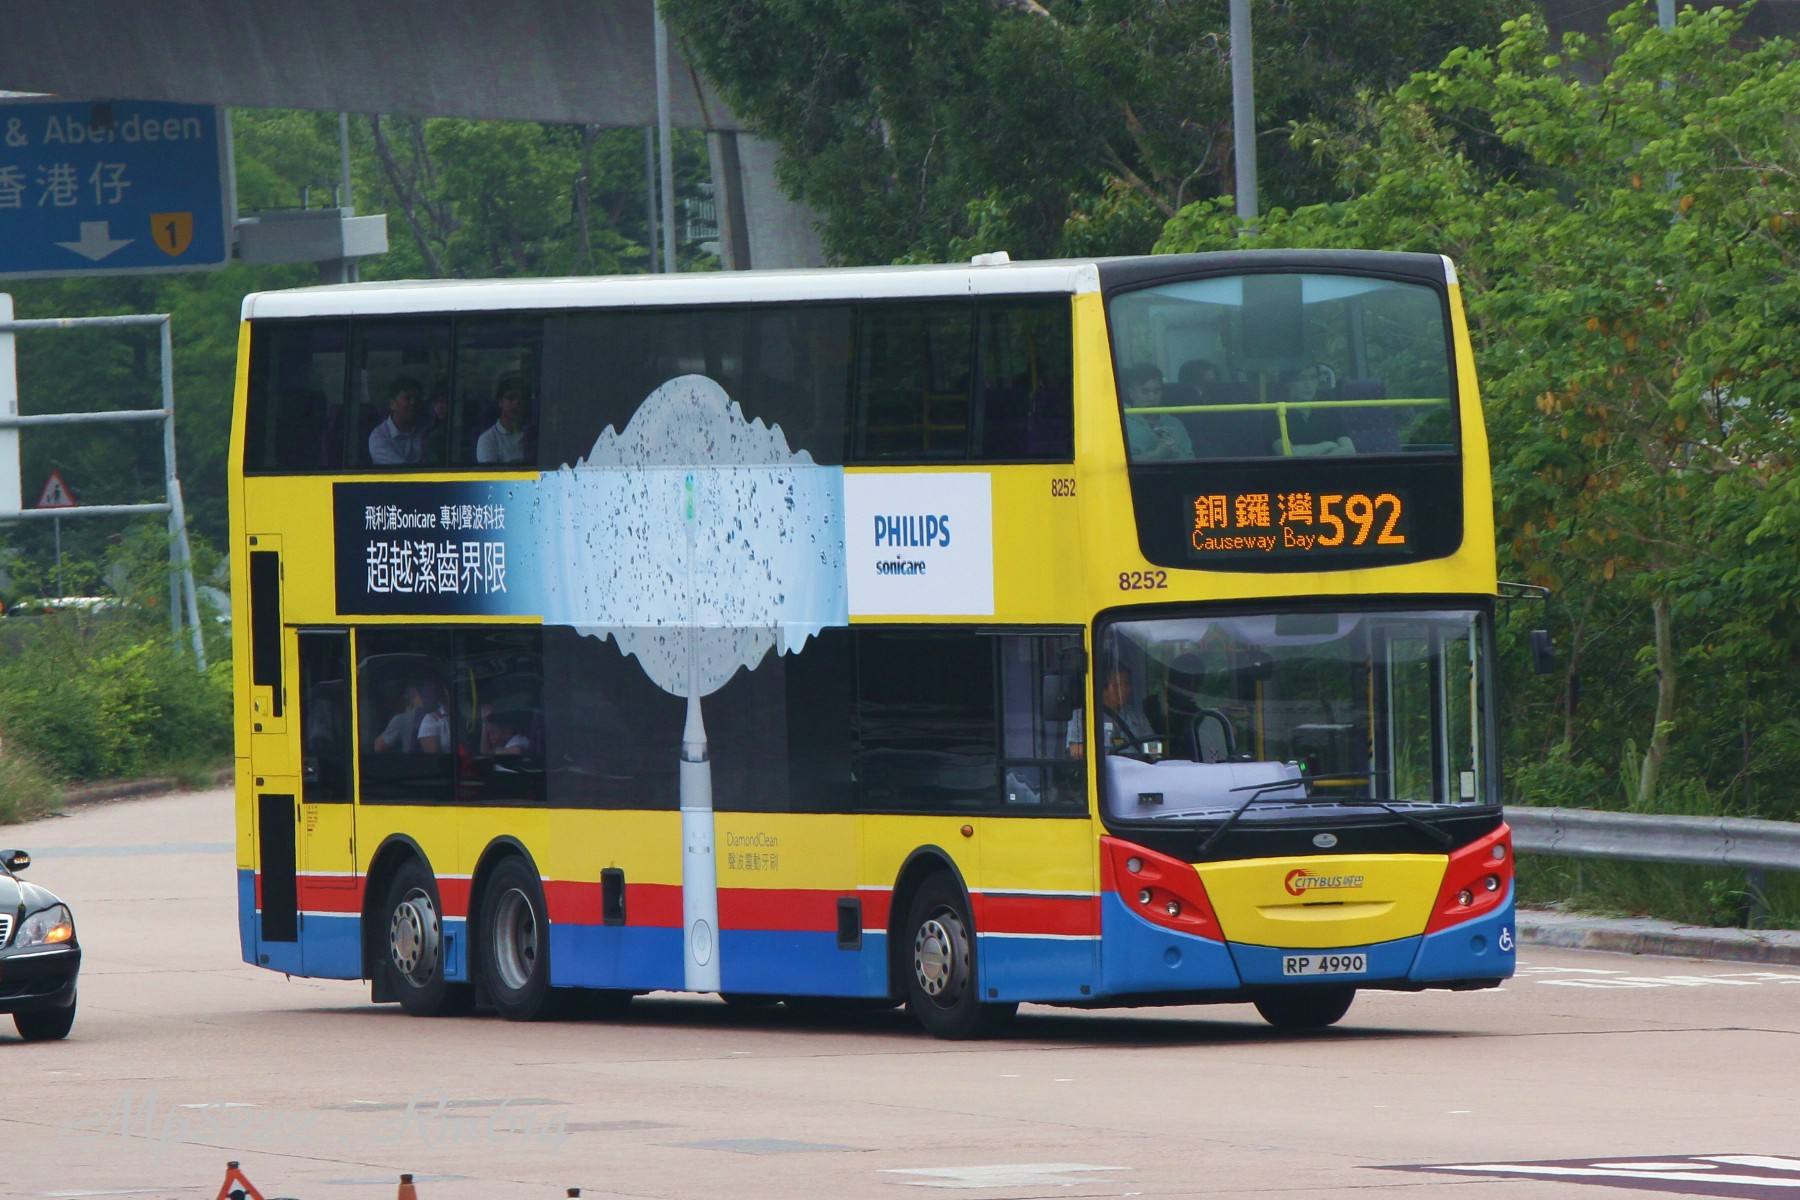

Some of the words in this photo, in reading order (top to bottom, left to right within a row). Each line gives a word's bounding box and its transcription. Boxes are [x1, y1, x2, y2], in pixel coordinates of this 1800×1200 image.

[4, 117, 29, 147] &
[42, 113, 202, 145] Aberdeen
[0, 160, 132, 208] 香港仔
[164, 220, 177, 249] 1
[1051, 478, 1076, 497] 8252
[439, 503, 505, 530] 專利聲波科技
[1194, 492, 1313, 529] 銅鑼灣
[1317, 493, 1405, 546] 592
[874, 514, 951, 548] PHILIPS
[1192, 529, 1277, 552] Causeway
[1283, 526, 1316, 551] Bay
[366, 539, 508, 594] 超越潔齒界限
[876, 553, 926, 576] sonicare
[1118, 570, 1168, 591] 8252
[726, 831, 778, 848] DiamondClean
[1295, 876, 1343, 889] CITYBUS
[1286, 957, 1310, 974] RP
[1317, 955, 1364, 973] 4990
